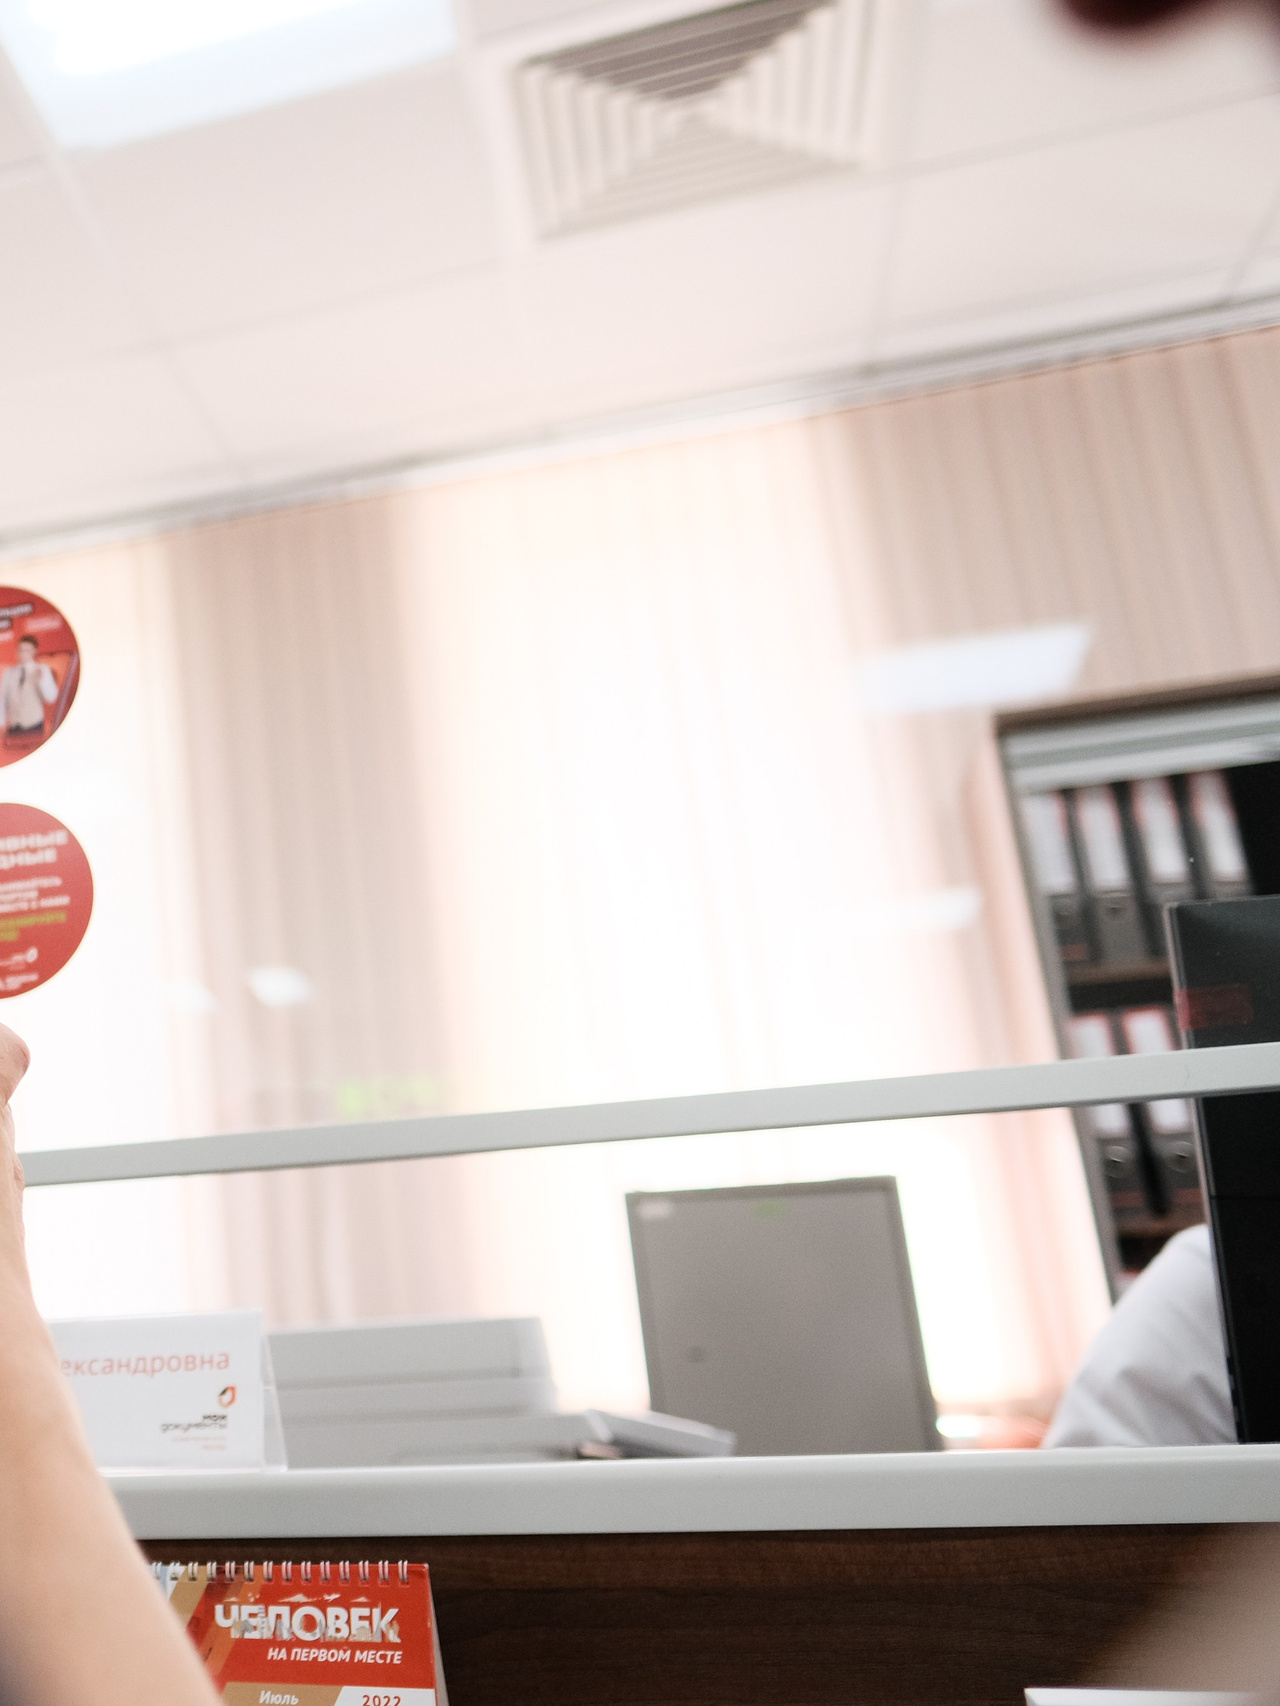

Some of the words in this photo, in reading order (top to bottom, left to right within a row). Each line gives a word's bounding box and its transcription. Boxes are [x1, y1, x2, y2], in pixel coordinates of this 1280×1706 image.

[214, 1604, 401, 1643] ЧЕЛОВЕК
[267, 1648, 287, 1660] НА
[290, 1648, 351, 1663] ПЕРВОМ
[353, 1650, 403, 1665] МЕСТЕ
[259, 1690, 300, 1706] Июль
[362, 1695, 402, 1706] 2022
